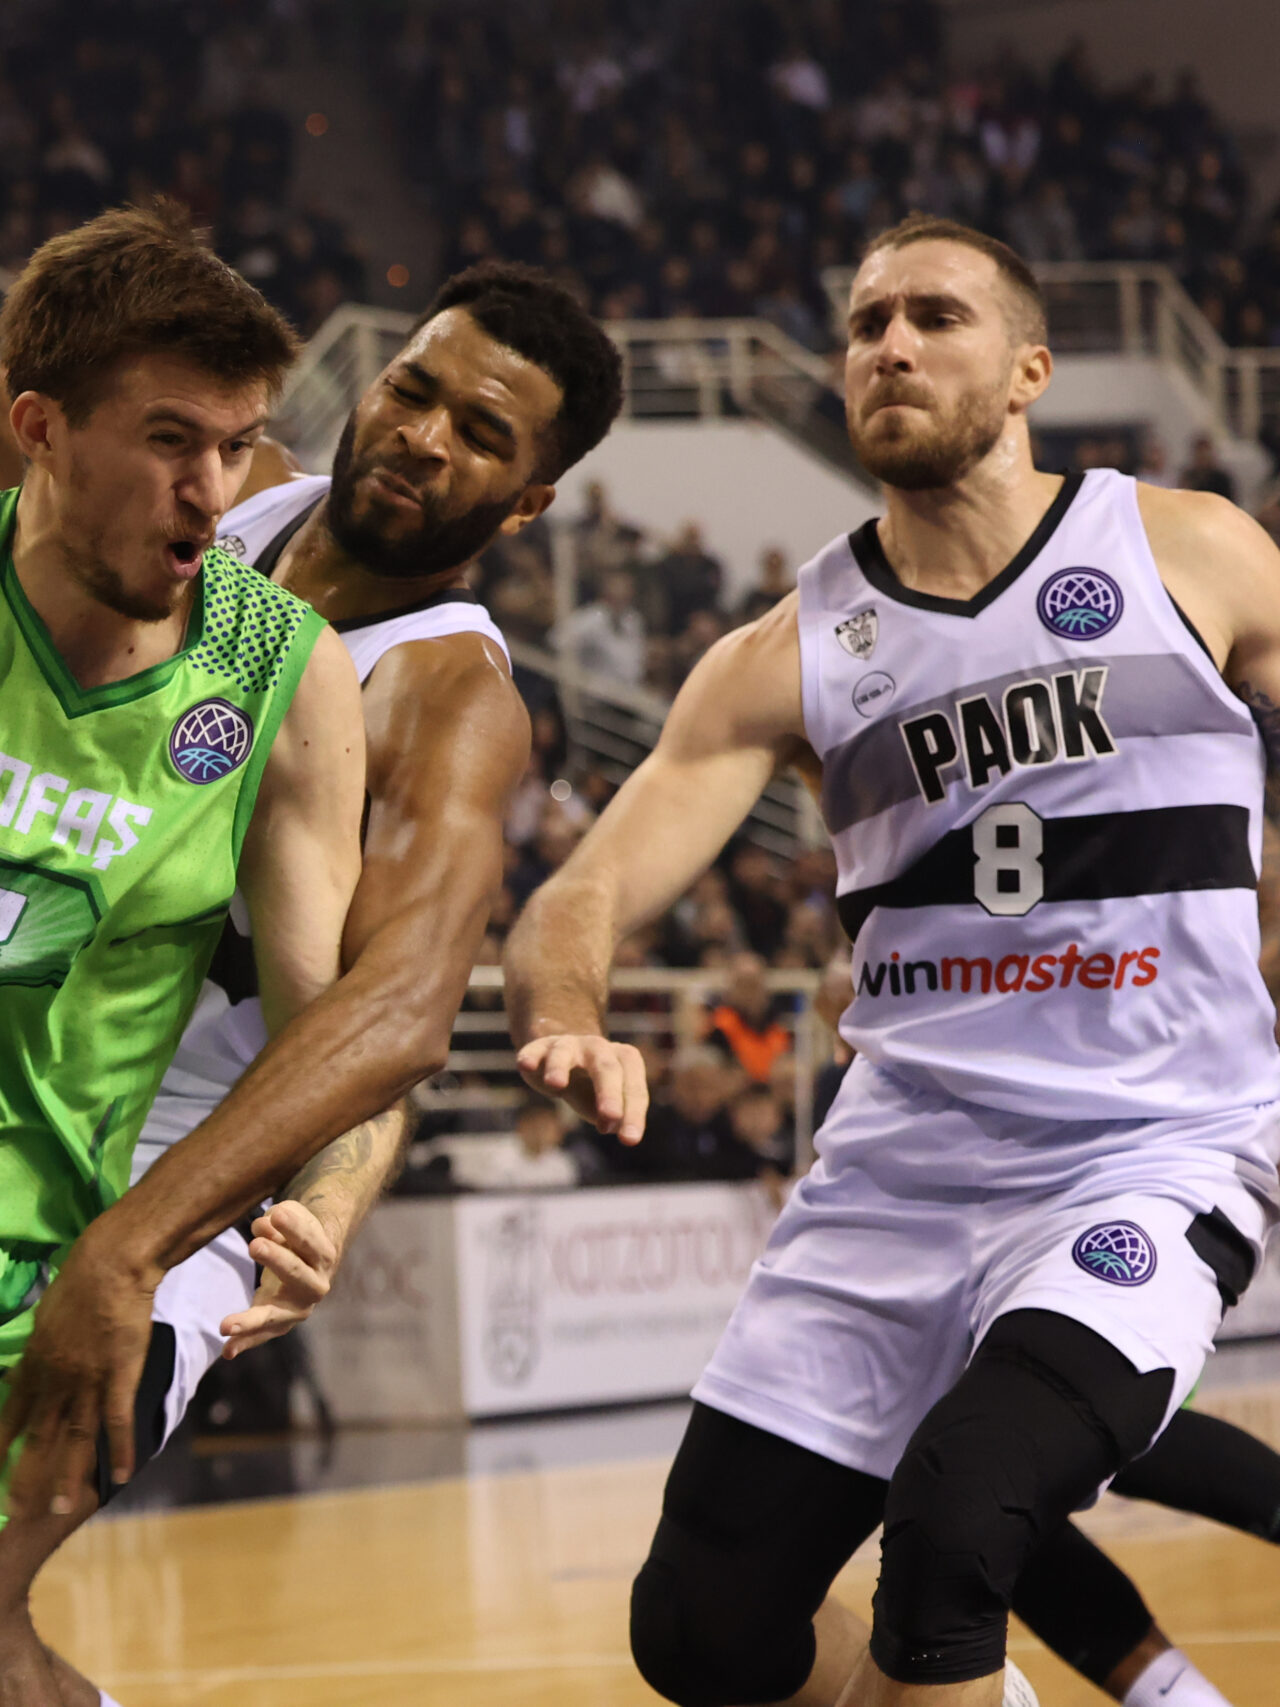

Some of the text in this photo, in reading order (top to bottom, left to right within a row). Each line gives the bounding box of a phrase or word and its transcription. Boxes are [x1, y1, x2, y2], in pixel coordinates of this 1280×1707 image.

[898, 666, 1120, 804] PAOK
[972, 801, 1044, 917] 8
[857, 943, 1161, 998] winmasters
